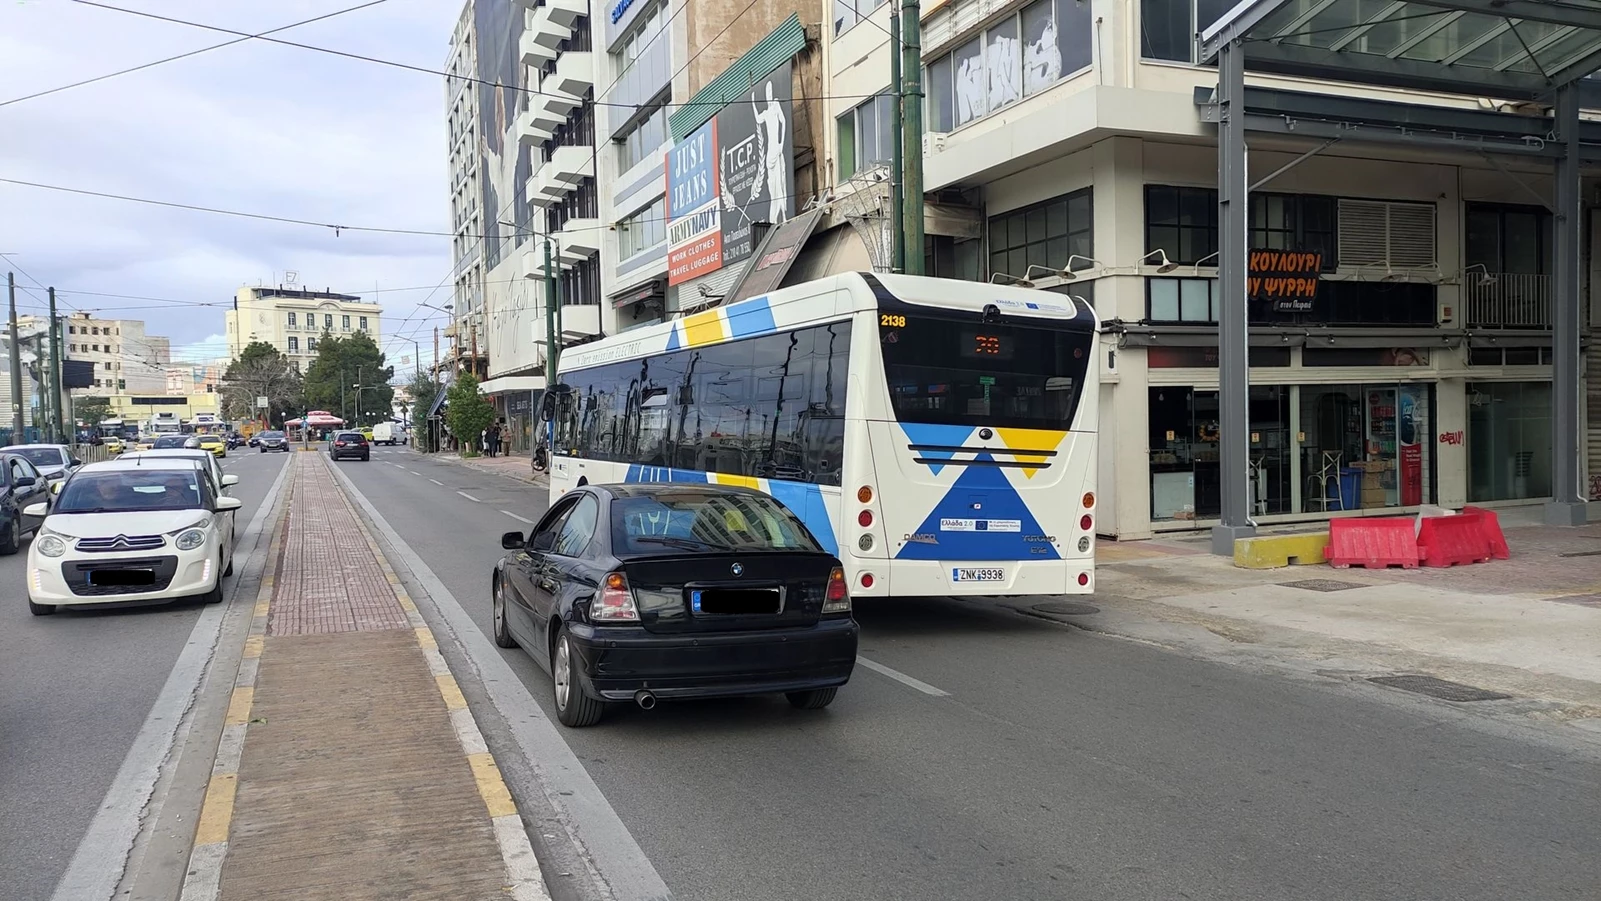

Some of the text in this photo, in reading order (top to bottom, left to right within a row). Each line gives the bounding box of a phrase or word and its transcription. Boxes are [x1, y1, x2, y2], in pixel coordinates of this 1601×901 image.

[675, 133, 705, 178] JUST
[727, 133, 756, 173] T.C.P.
[673, 170, 707, 212] JEANS
[672, 251, 687, 263] WORK
[688, 238, 715, 256] CLOTHES
[670, 264, 689, 277] TRAVEL
[690, 251, 719, 270] LUGGAGE
[1250, 252, 1321, 272] ΚΟΥΛΟΥΡΙ
[1264, 277, 1317, 297] ΨΥΡΡΗ
[881, 314, 906, 328] 2138
[614, 342, 642, 359] ELECTRIC
[941, 519, 963, 527] Ελλάδα
